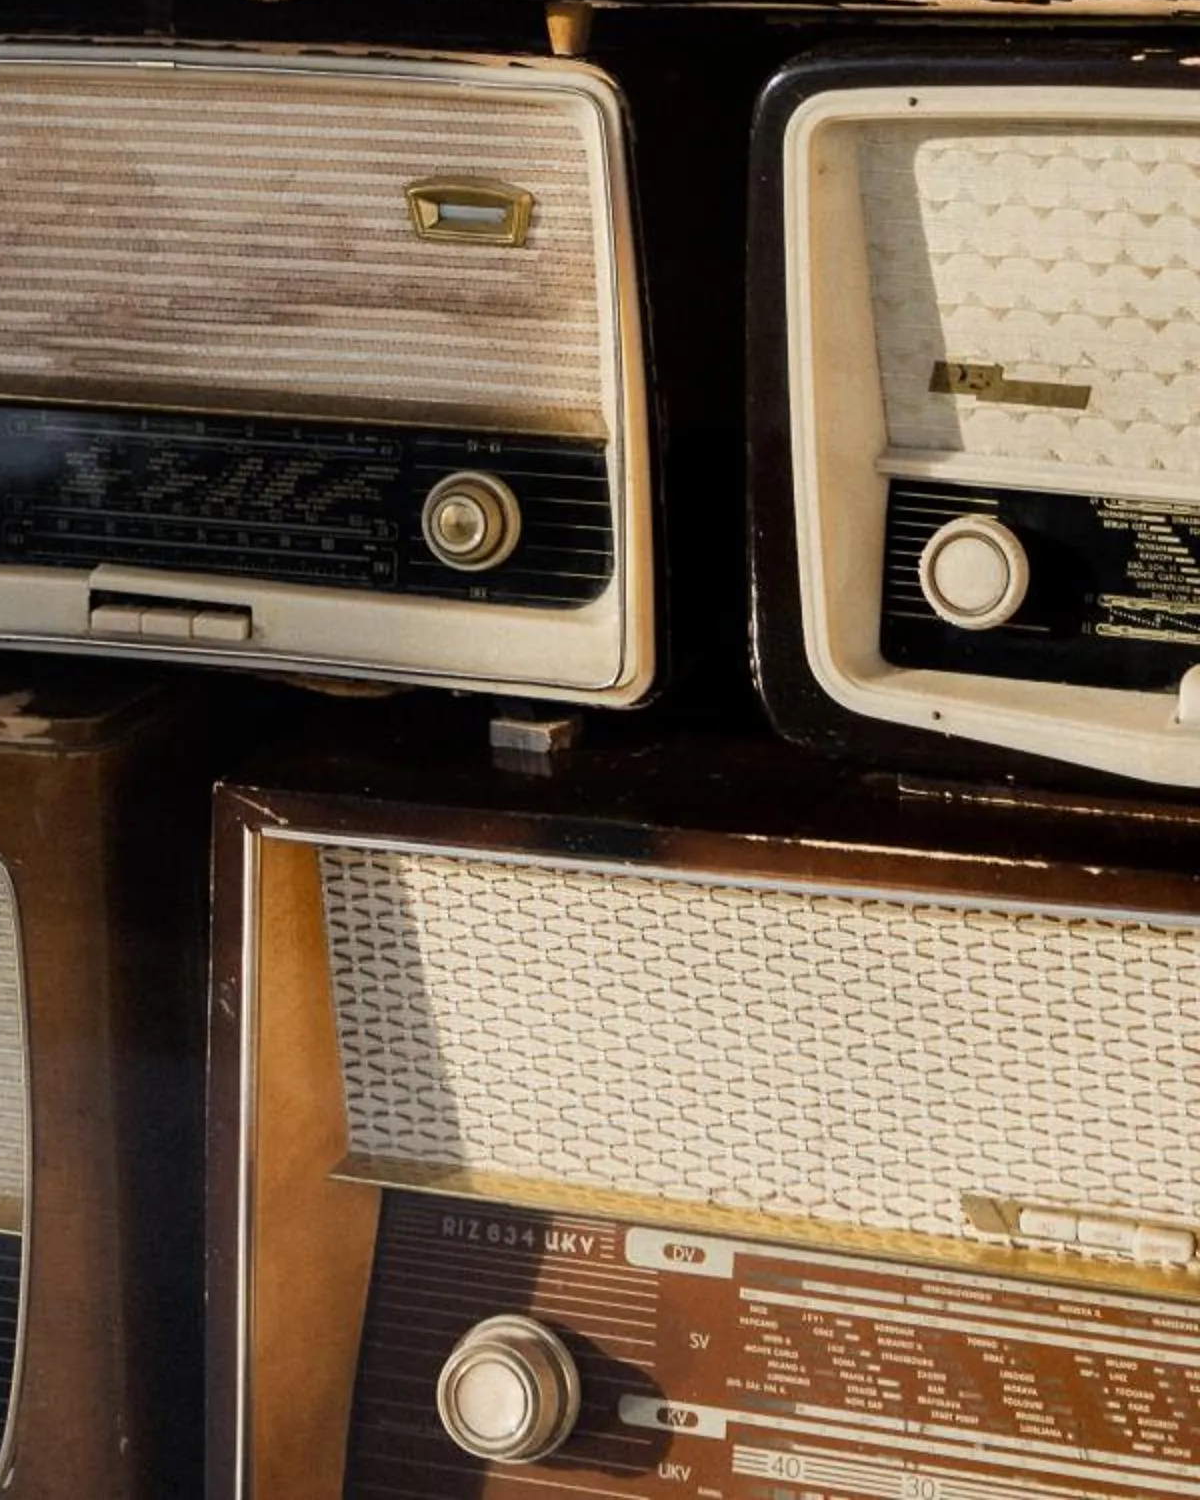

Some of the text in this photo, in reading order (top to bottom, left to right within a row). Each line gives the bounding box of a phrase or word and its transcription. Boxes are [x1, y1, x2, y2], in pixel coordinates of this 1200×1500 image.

[544, 1229, 595, 1255] UKV
[673, 1245, 696, 1263] DV
[689, 1332, 711, 1350] SV
[666, 1408, 688, 1427] KV
[657, 1462, 692, 1483] UKV
[770, 1455, 801, 1479] 40
[905, 1475, 936, 1500] 30
